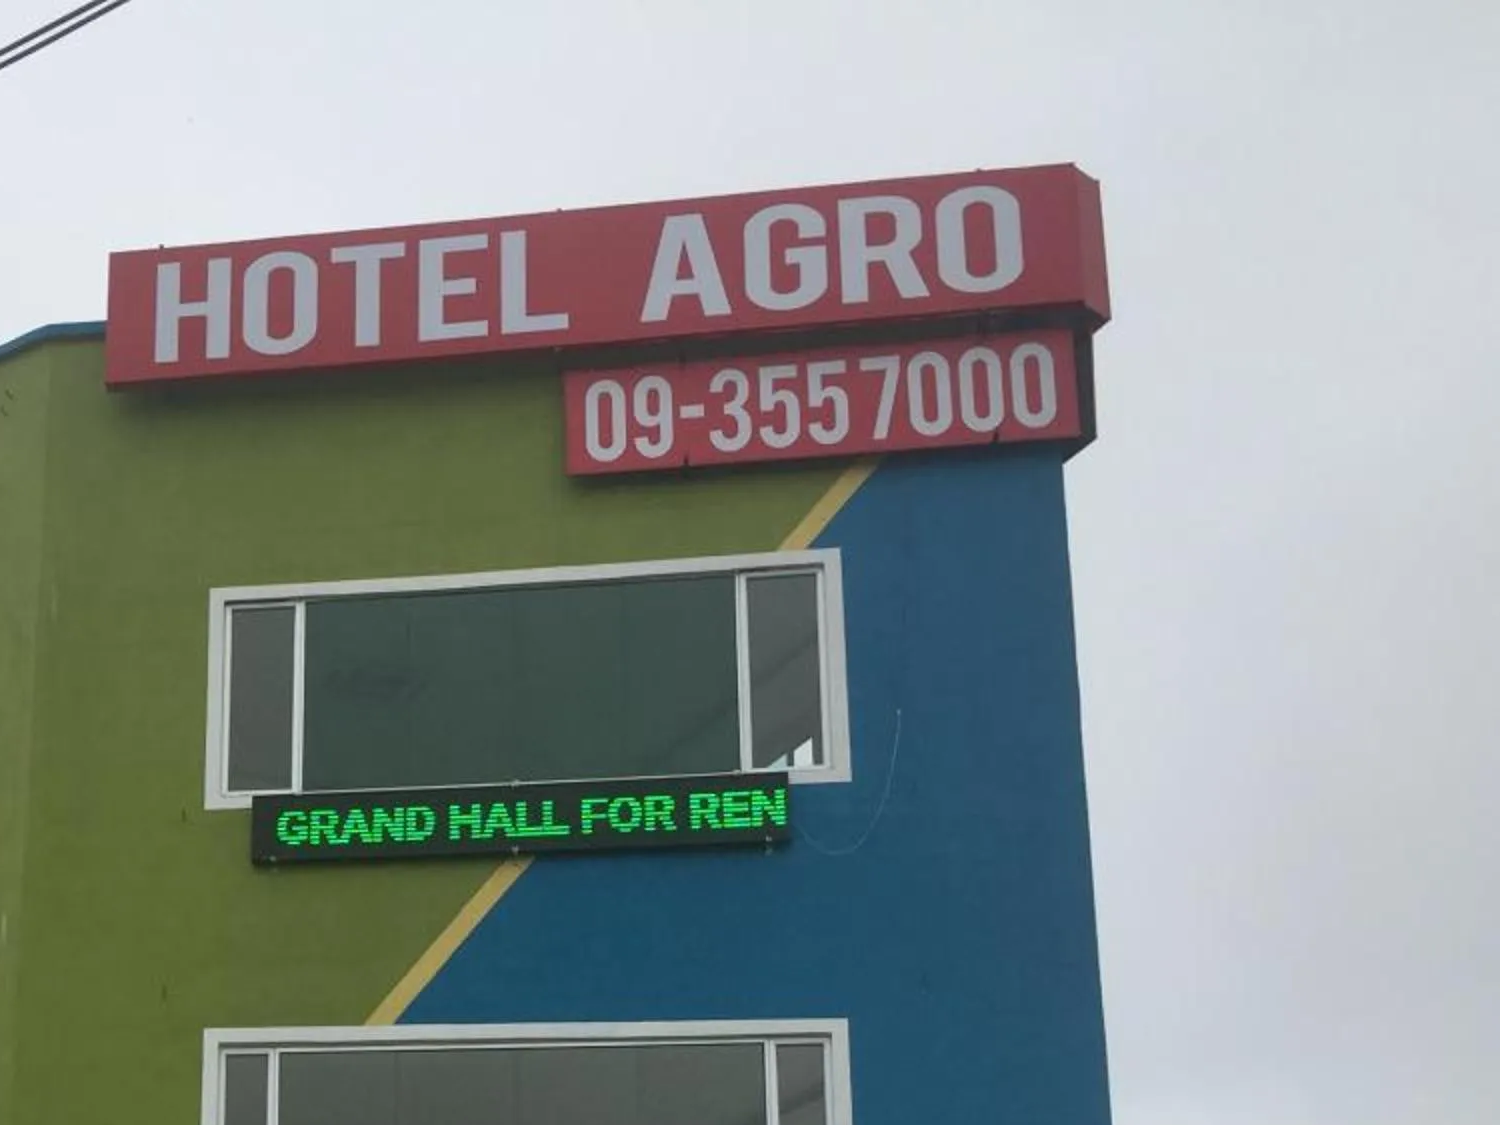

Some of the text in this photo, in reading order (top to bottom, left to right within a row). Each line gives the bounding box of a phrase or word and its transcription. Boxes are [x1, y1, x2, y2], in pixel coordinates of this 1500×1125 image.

[154, 185, 1025, 366] HOTEL AGRO
[277, 789, 787, 846] GRAND HALL FOR REN
